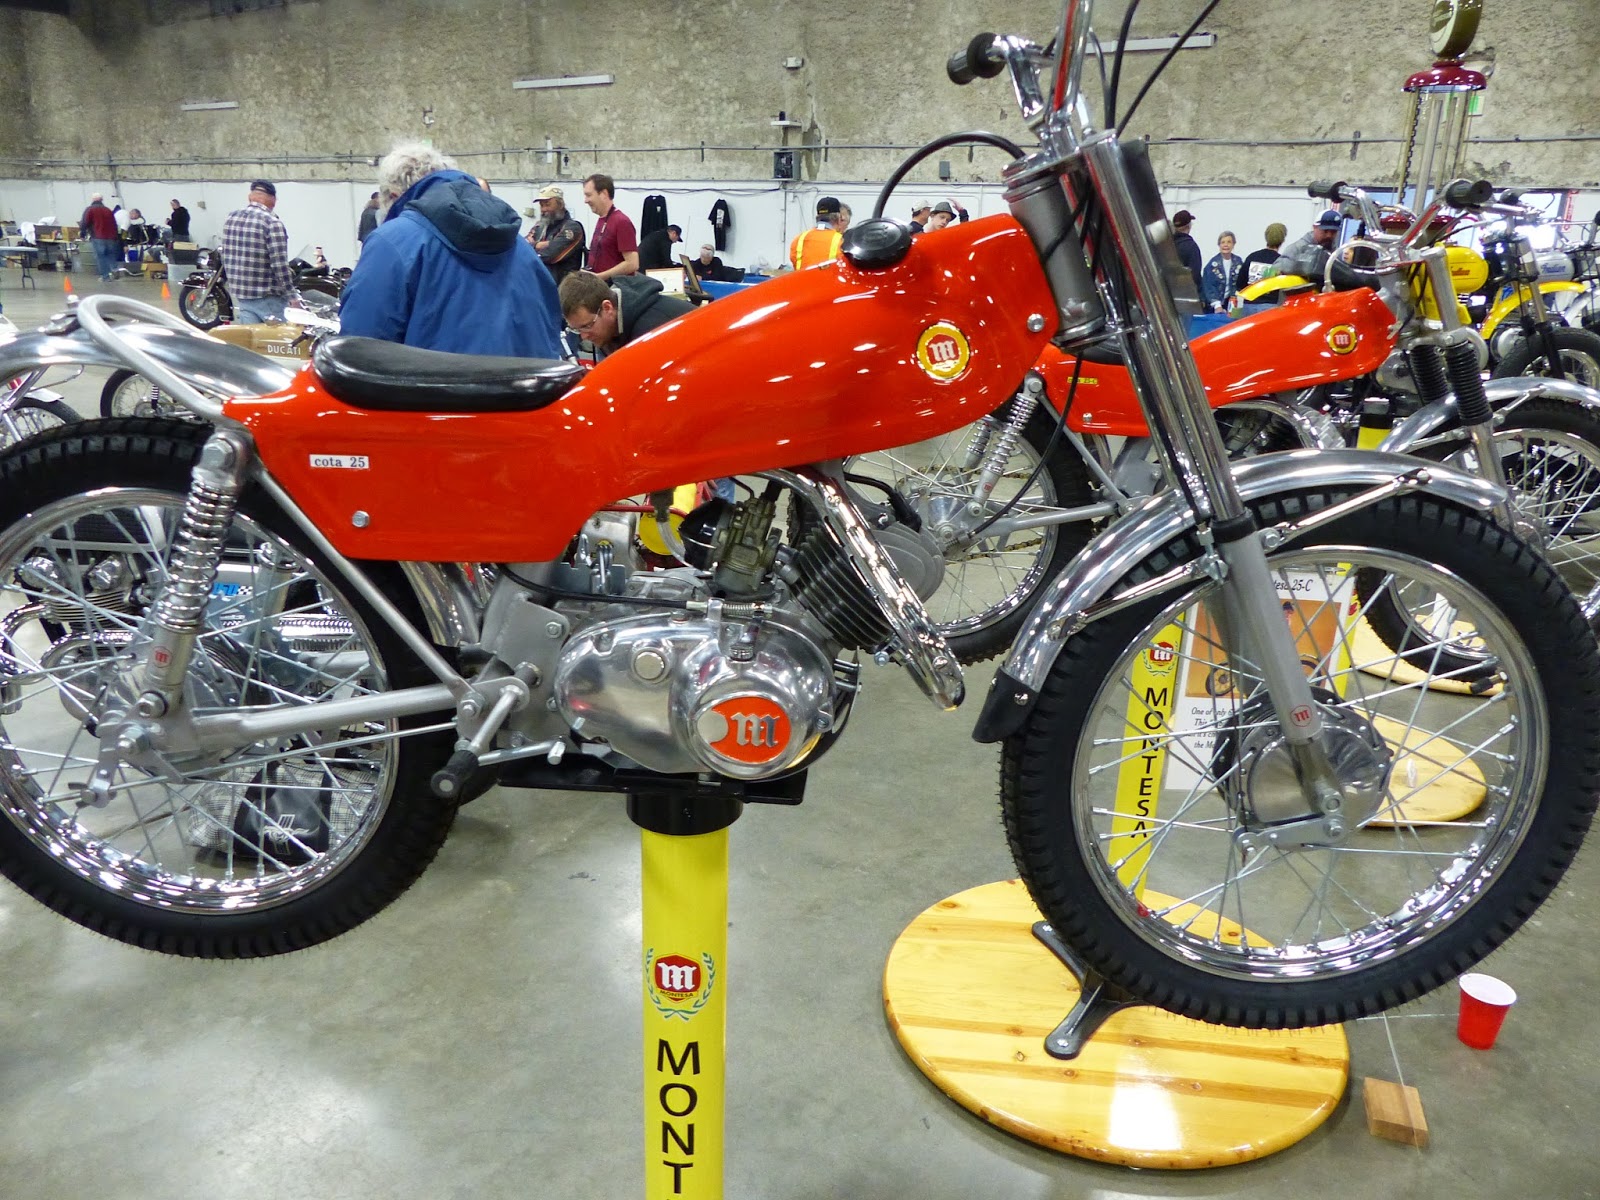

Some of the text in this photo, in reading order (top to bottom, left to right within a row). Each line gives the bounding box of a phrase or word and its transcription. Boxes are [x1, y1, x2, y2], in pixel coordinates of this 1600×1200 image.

[267, 344, 301, 355] DUCATI
[314, 456, 366, 468] cota 25
[1131, 687, 1168, 839] MONTESA
[660, 990, 694, 998] MONTESA
[657, 1038, 701, 1200] MONT
